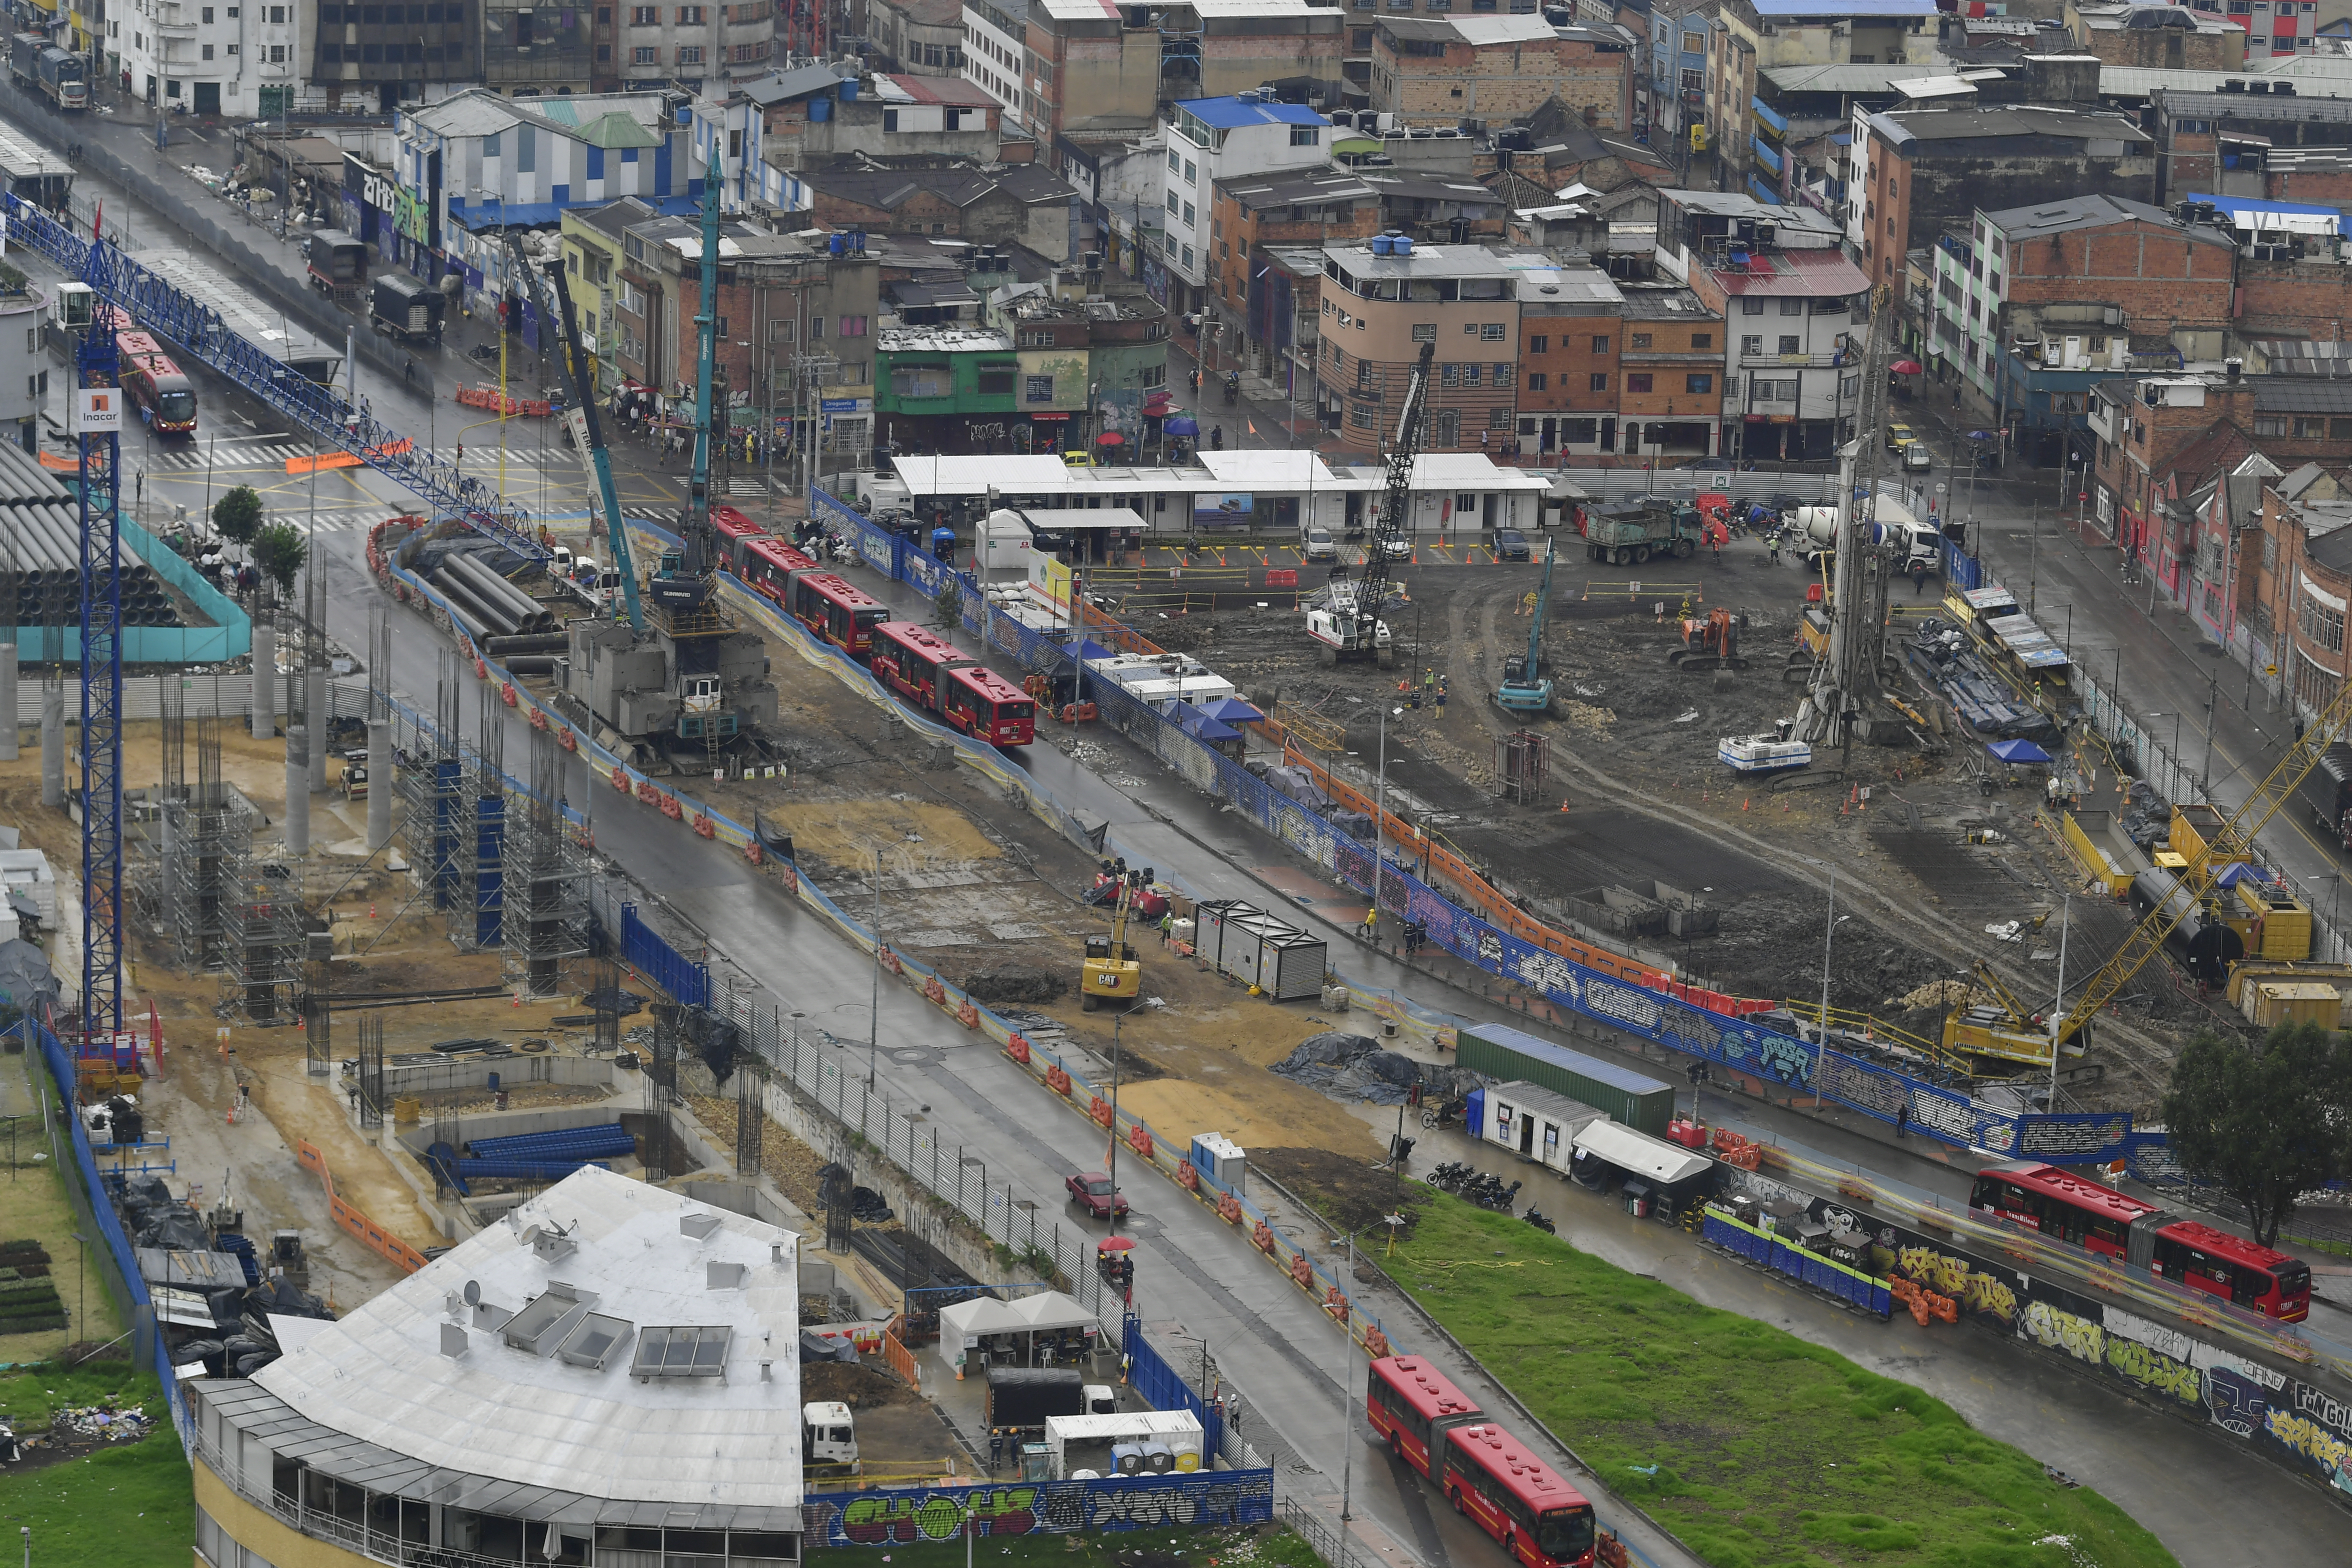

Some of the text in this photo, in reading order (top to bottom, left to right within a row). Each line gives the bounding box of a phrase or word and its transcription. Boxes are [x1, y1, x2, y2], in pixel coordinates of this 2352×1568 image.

[83, 412, 118, 421] Inacar
[581, 430, 593, 456] TEREX
[1098, 975, 1116, 985] CAT
[1984, 1203, 2039, 1227] T1050 TransMilenio
[2280, 1301, 2292, 1310] T1050
[1474, 1490, 1497, 1515] TransMilenio
